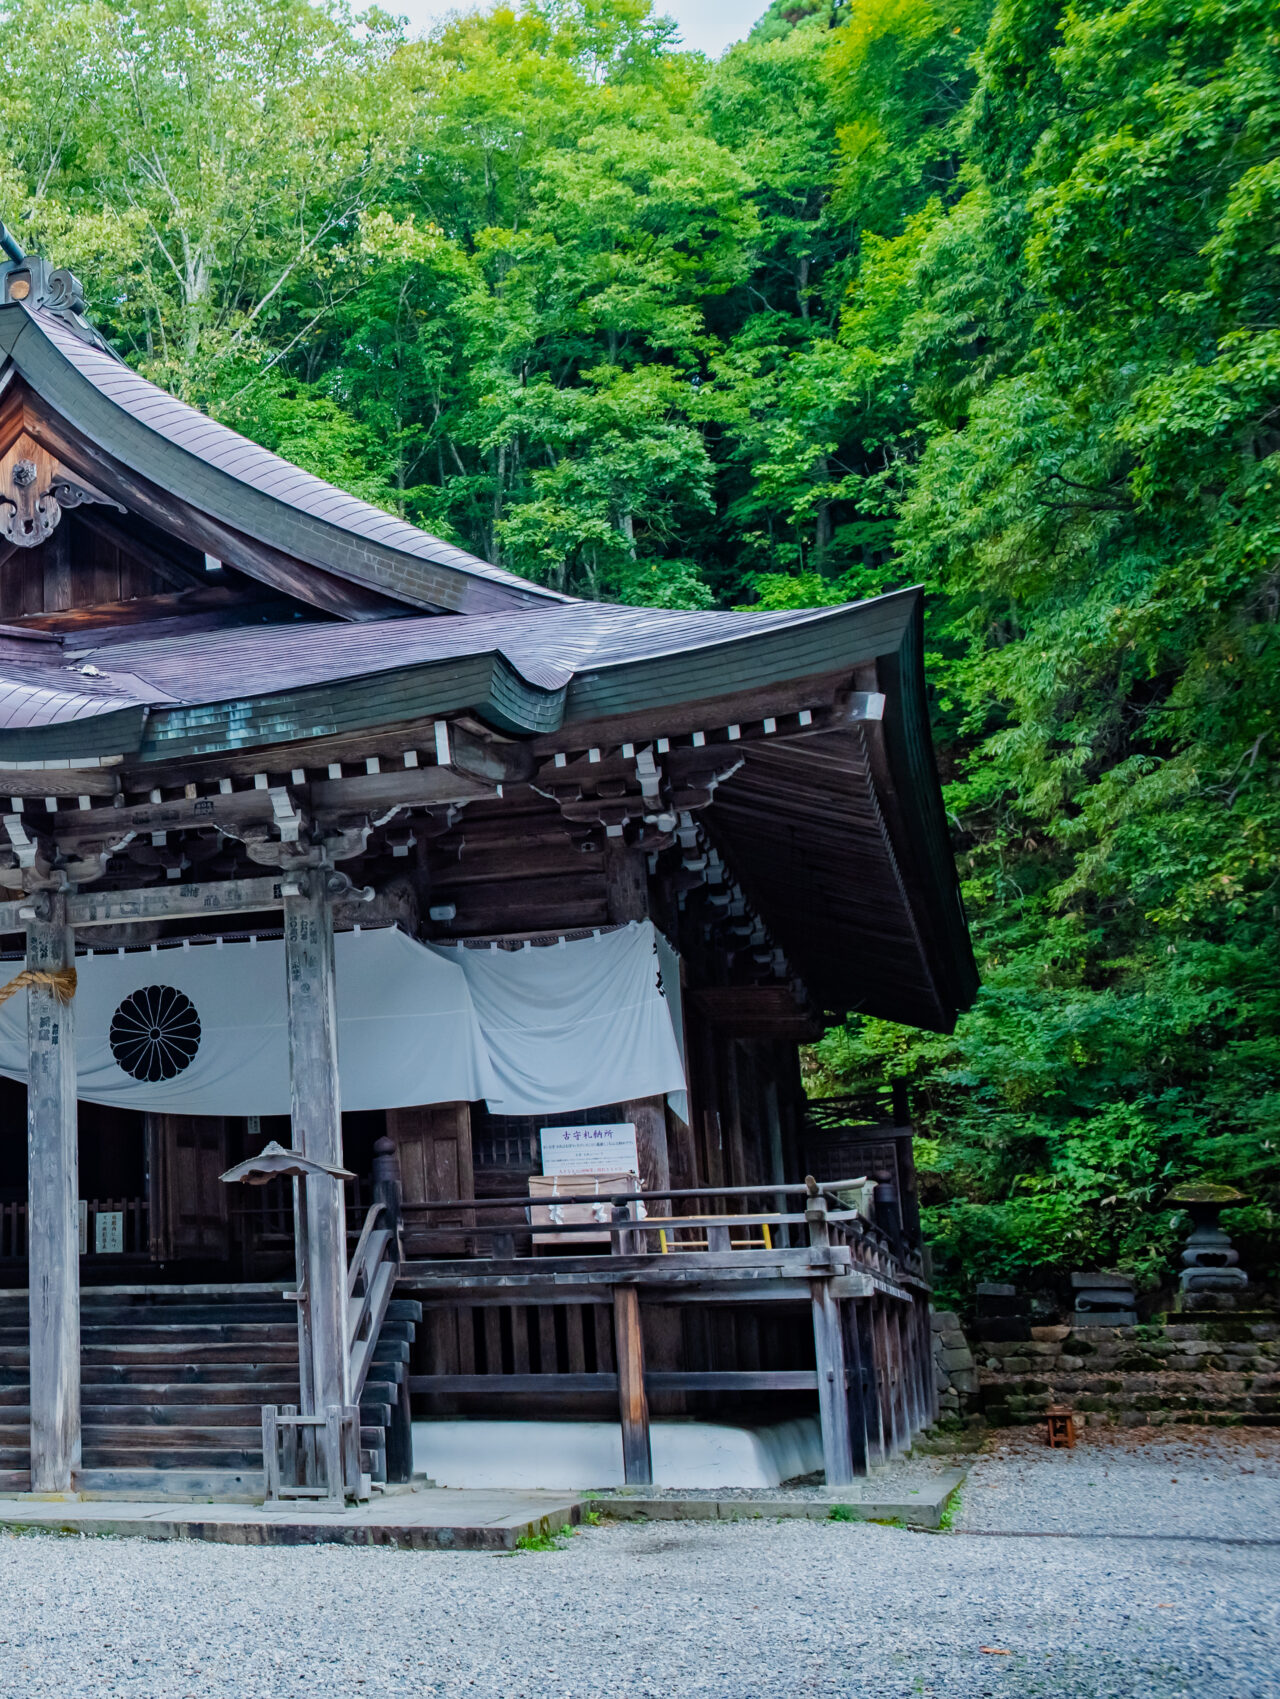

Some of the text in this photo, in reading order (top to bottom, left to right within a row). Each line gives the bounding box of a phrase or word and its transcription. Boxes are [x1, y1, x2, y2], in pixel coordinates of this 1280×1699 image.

[562, 1129, 614, 1141] 古守札納所
